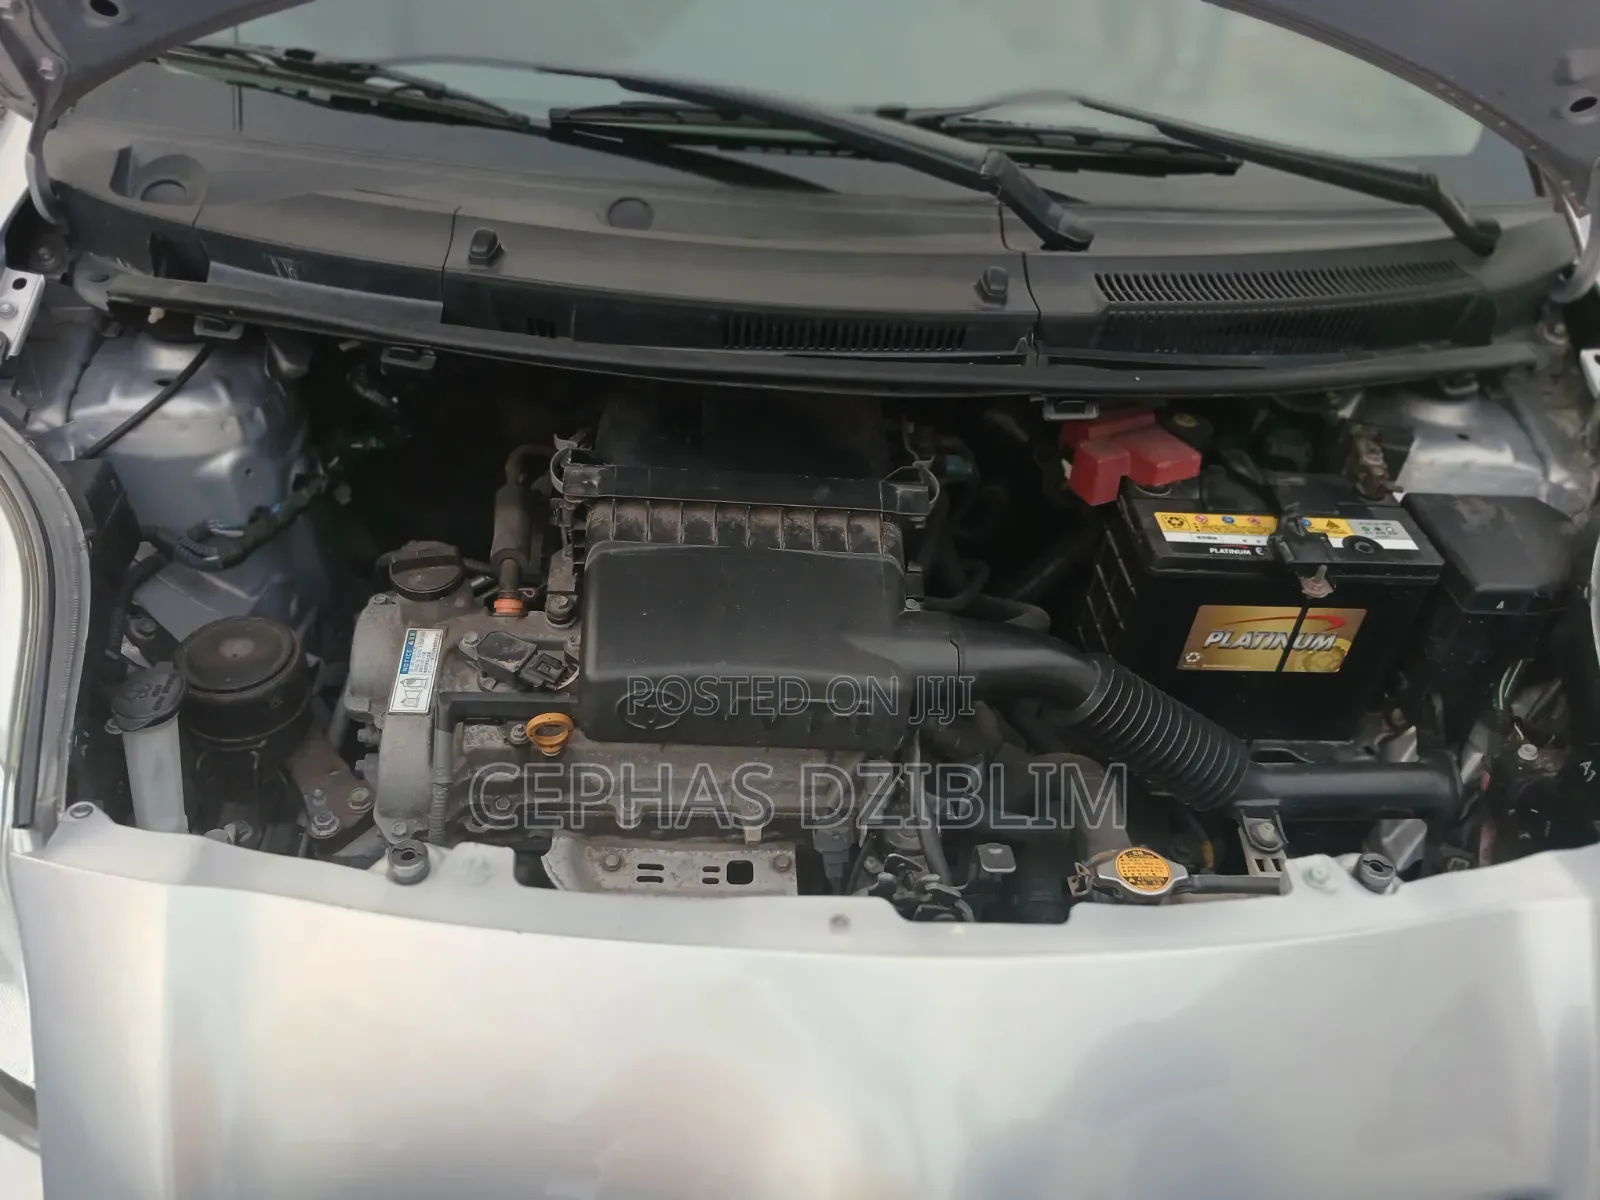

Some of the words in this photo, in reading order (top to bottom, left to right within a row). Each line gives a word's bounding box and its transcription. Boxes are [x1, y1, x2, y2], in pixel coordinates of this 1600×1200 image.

[1209, 547, 1251, 556] PLATINUM
[1203, 630, 1338, 651] PLATINUM
[402, 649, 412, 672] NOTICE
